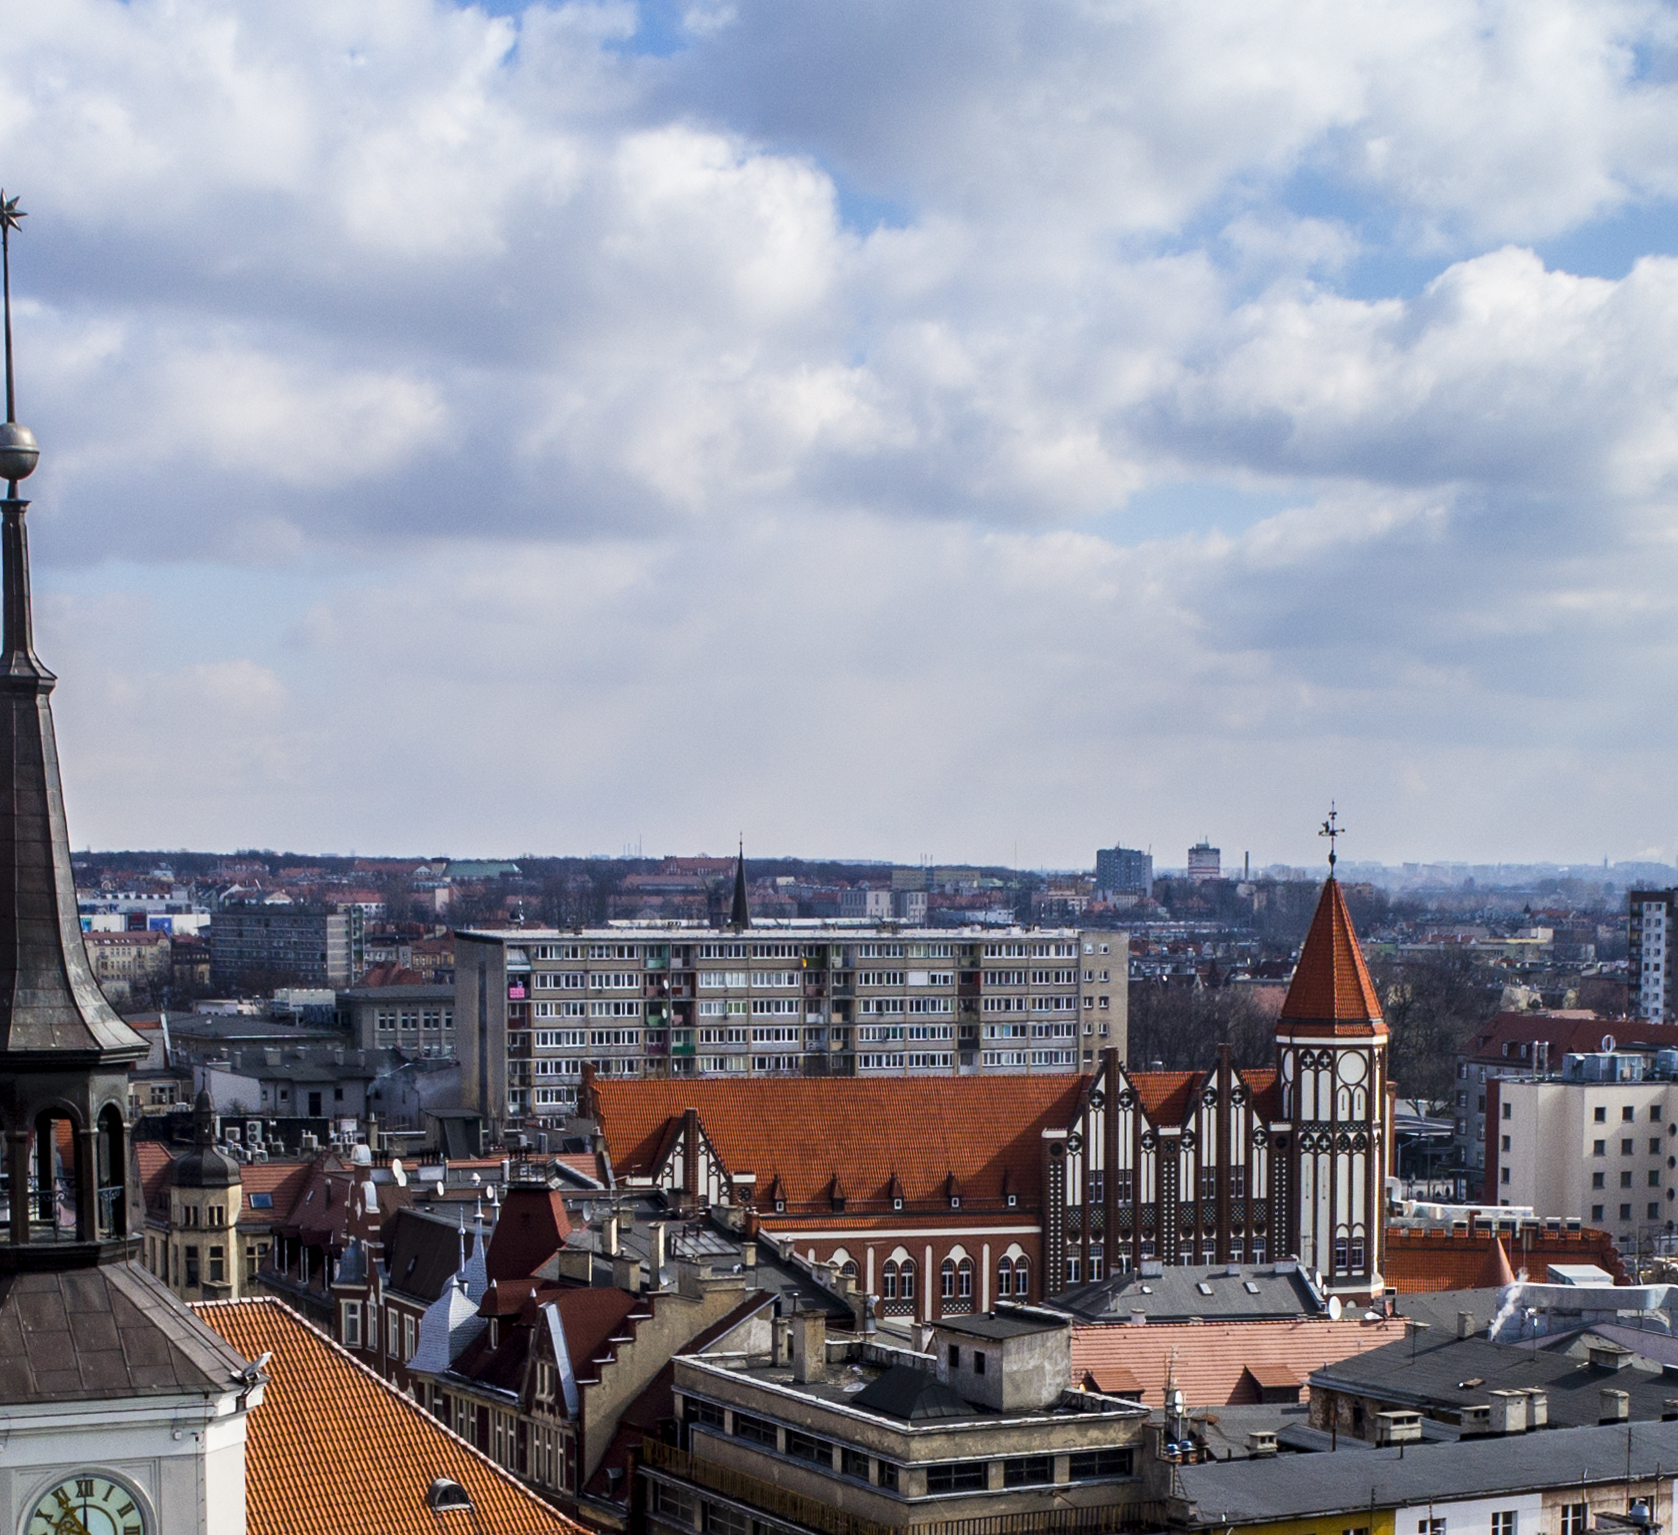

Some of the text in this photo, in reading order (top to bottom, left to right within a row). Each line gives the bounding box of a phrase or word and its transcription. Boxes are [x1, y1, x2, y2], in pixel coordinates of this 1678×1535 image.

[75, 1479, 95, 1498] XII
[102, 1485, 116, 1502] I
[117, 1501, 135, 1518] II
